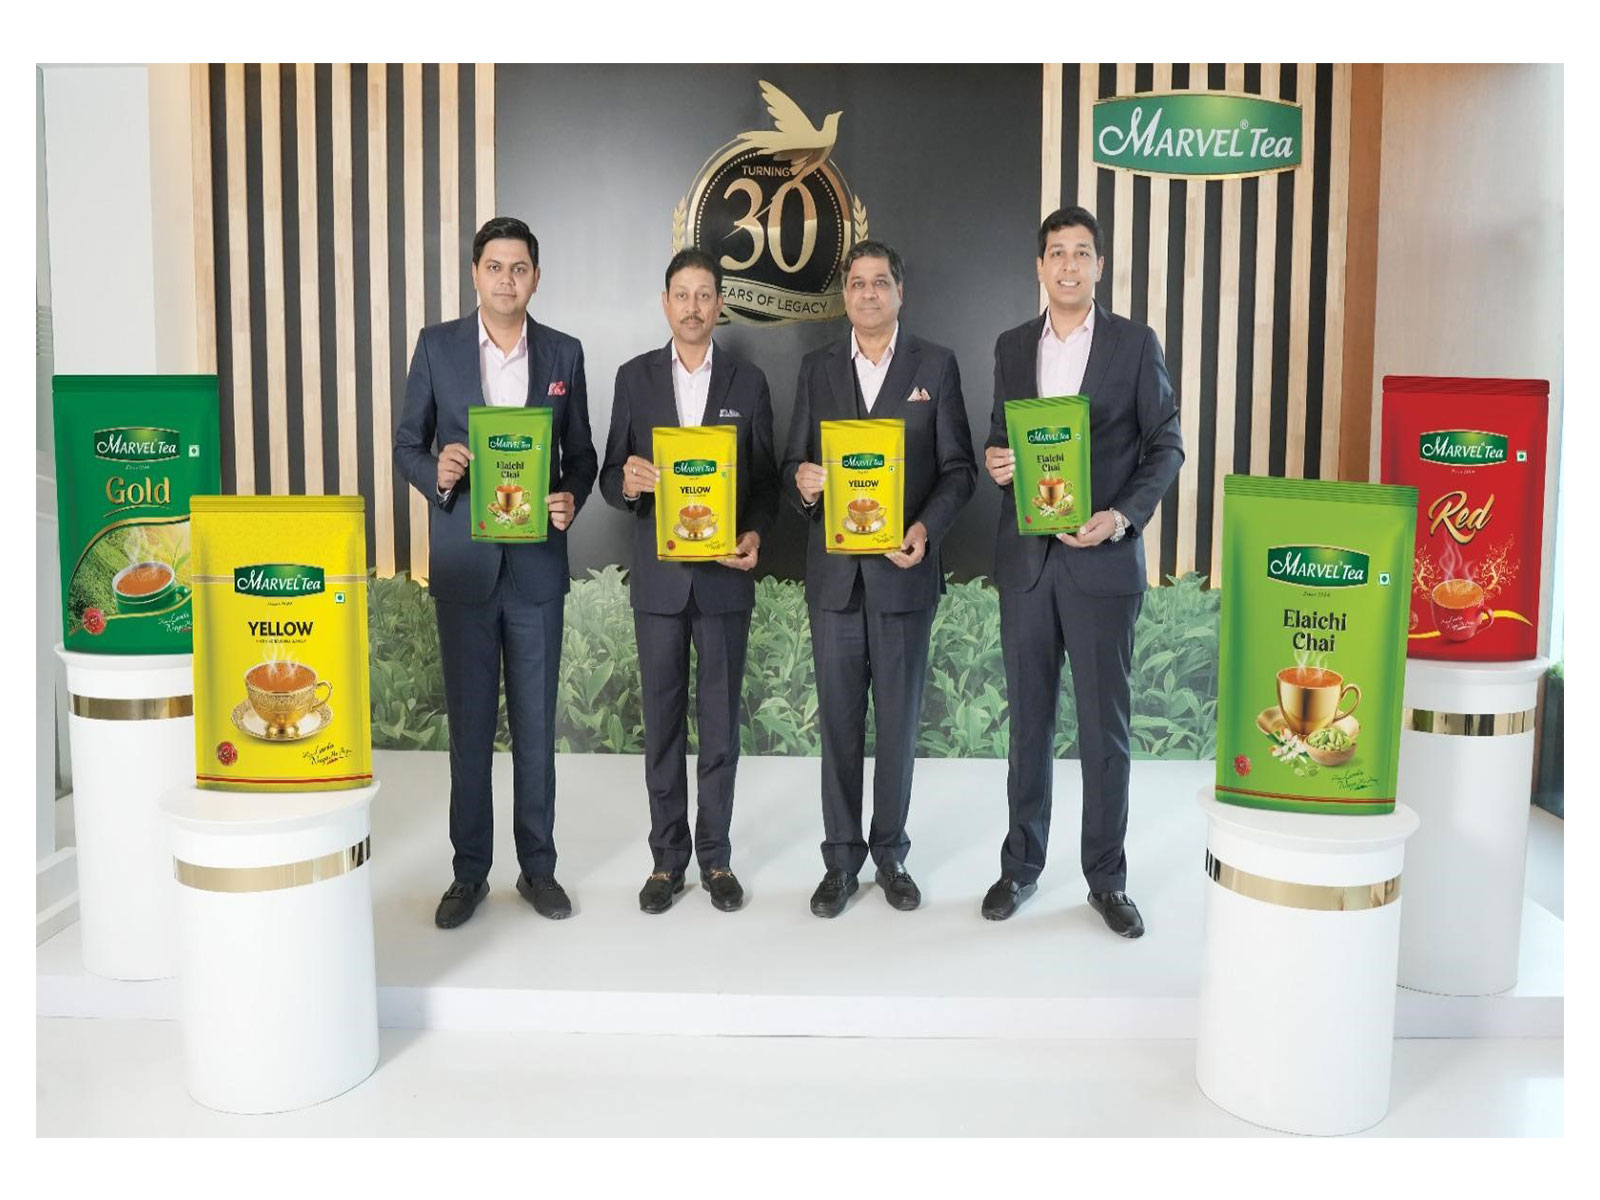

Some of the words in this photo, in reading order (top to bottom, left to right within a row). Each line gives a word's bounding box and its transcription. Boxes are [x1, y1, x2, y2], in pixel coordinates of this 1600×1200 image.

[1249, 128, 1293, 158] Tea
[742, 165, 790, 177] TURNING
[720, 178, 818, 273] 30
[721, 286, 754, 302] EARS
[757, 294, 776, 306] OF
[778, 300, 828, 314] LEGACY
[157, 445, 177, 455] Tea
[1484, 445, 1504, 459] Tea
[105, 476, 171, 505] Gold
[680, 486, 711, 494] YELLOW
[848, 480, 879, 488] YELLOW
[1428, 490, 1495, 544] Red
[1341, 564, 1364, 581] Tea
[301, 578, 321, 591] Tea
[1283, 608, 1347, 631] Elaichi
[248, 621, 314, 636] YELLOW
[1293, 632, 1335, 653] Chai
